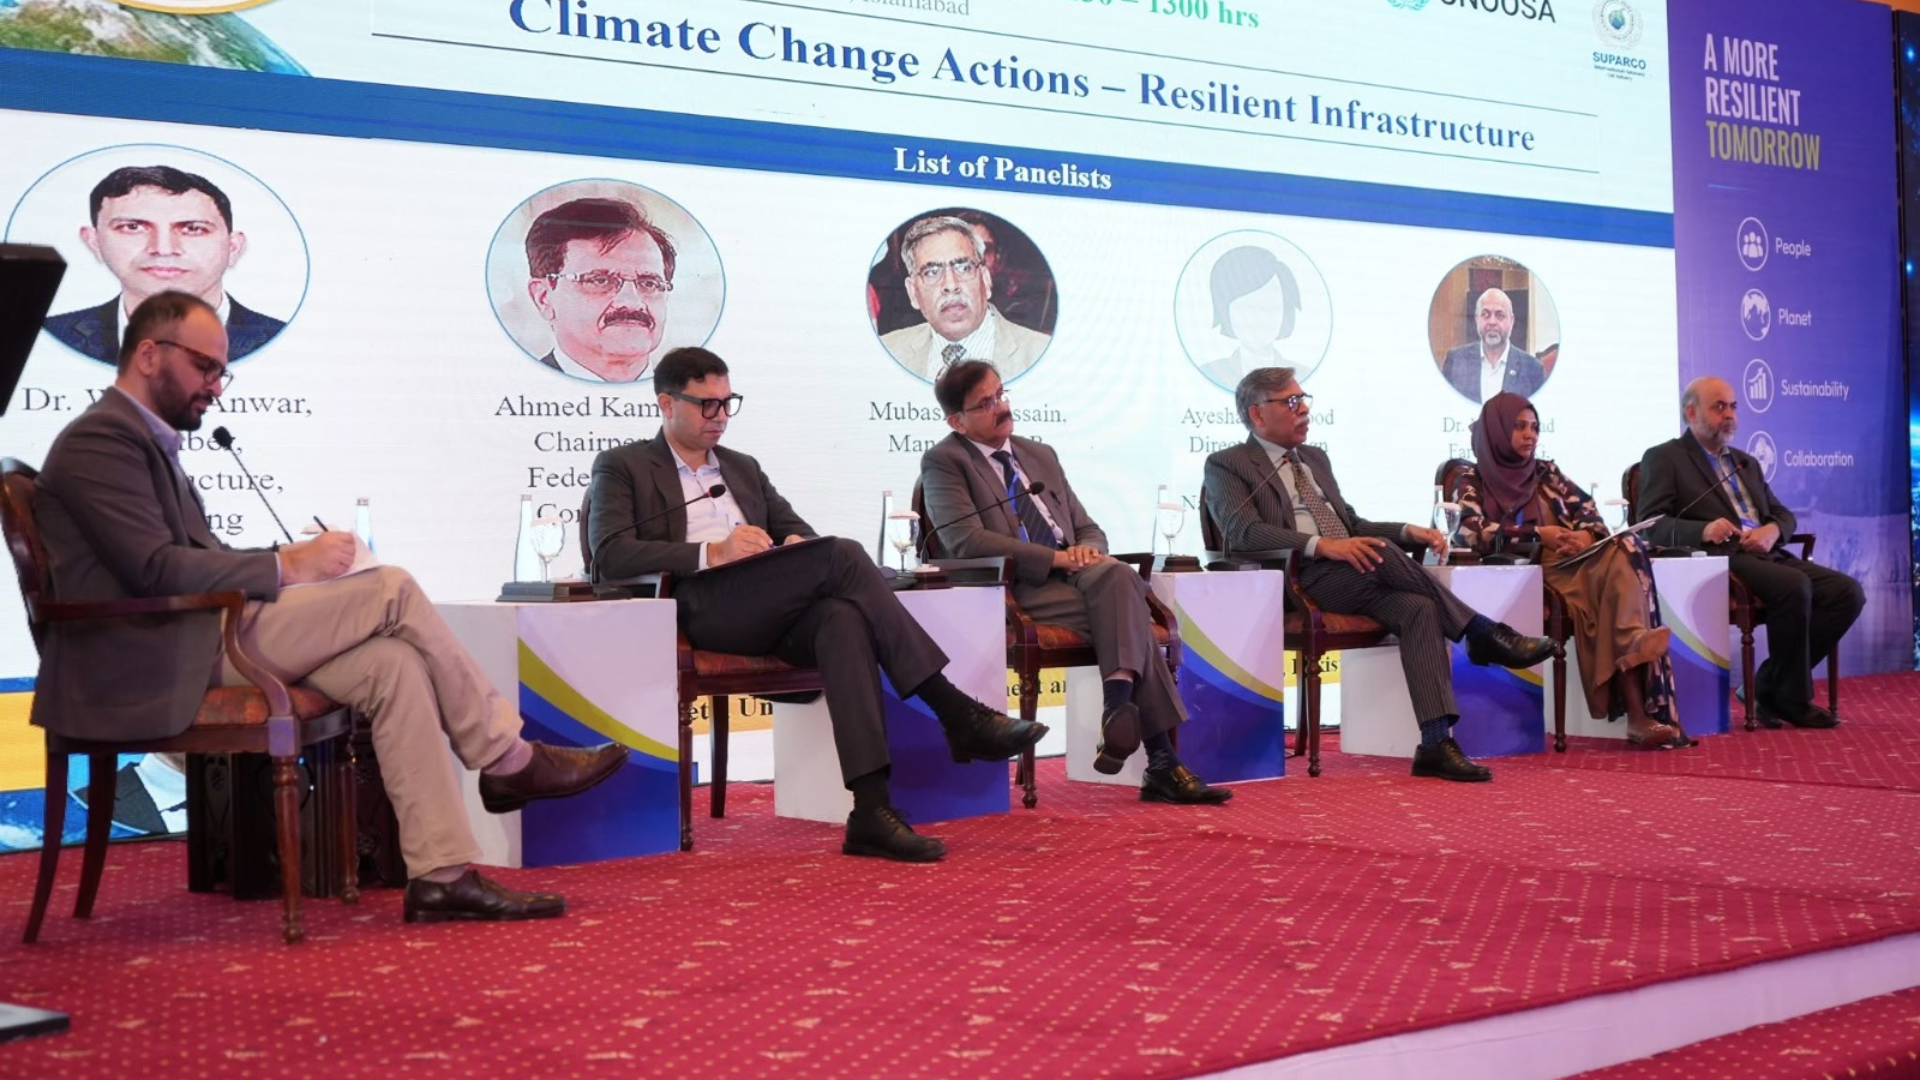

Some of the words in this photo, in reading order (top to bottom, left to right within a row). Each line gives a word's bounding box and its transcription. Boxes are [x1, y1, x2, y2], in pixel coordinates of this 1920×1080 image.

[865, 0, 970, 16] amabad
[1218, 1, 1260, 28] hrs
[1441, 0, 1556, 23] OOSA
[1593, 51, 1646, 70] SUPARCO
[1704, 33, 1718, 72] A
[1723, 36, 1779, 81] MORE
[509, 0, 721, 54] Climate
[738, 22, 919, 84] Change
[932, 47, 1090, 98] Actions
[1137, 72, 1297, 122] Resilient
[1309, 94, 1535, 151] Infrastructure
[1705, 76, 1801, 127] RESILIENT
[1706, 120, 1820, 171] TOMORROW
[893, 147, 951, 176] List
[958, 155, 990, 179] of
[994, 156, 1112, 190] Panelists
[1775, 237, 1812, 257] People
[1778, 308, 1812, 326] Planet
[22, 387, 72, 411] Dr.
[1781, 379, 1849, 401] Sustainability
[494, 396, 592, 418] Ahmed
[600, 397, 660, 418] Kam
[869, 401, 946, 421] Mubas
[1013, 403, 1067, 424] ssain,
[1784, 450, 1854, 467] Collaboration
[528, 467, 590, 487] Fede
